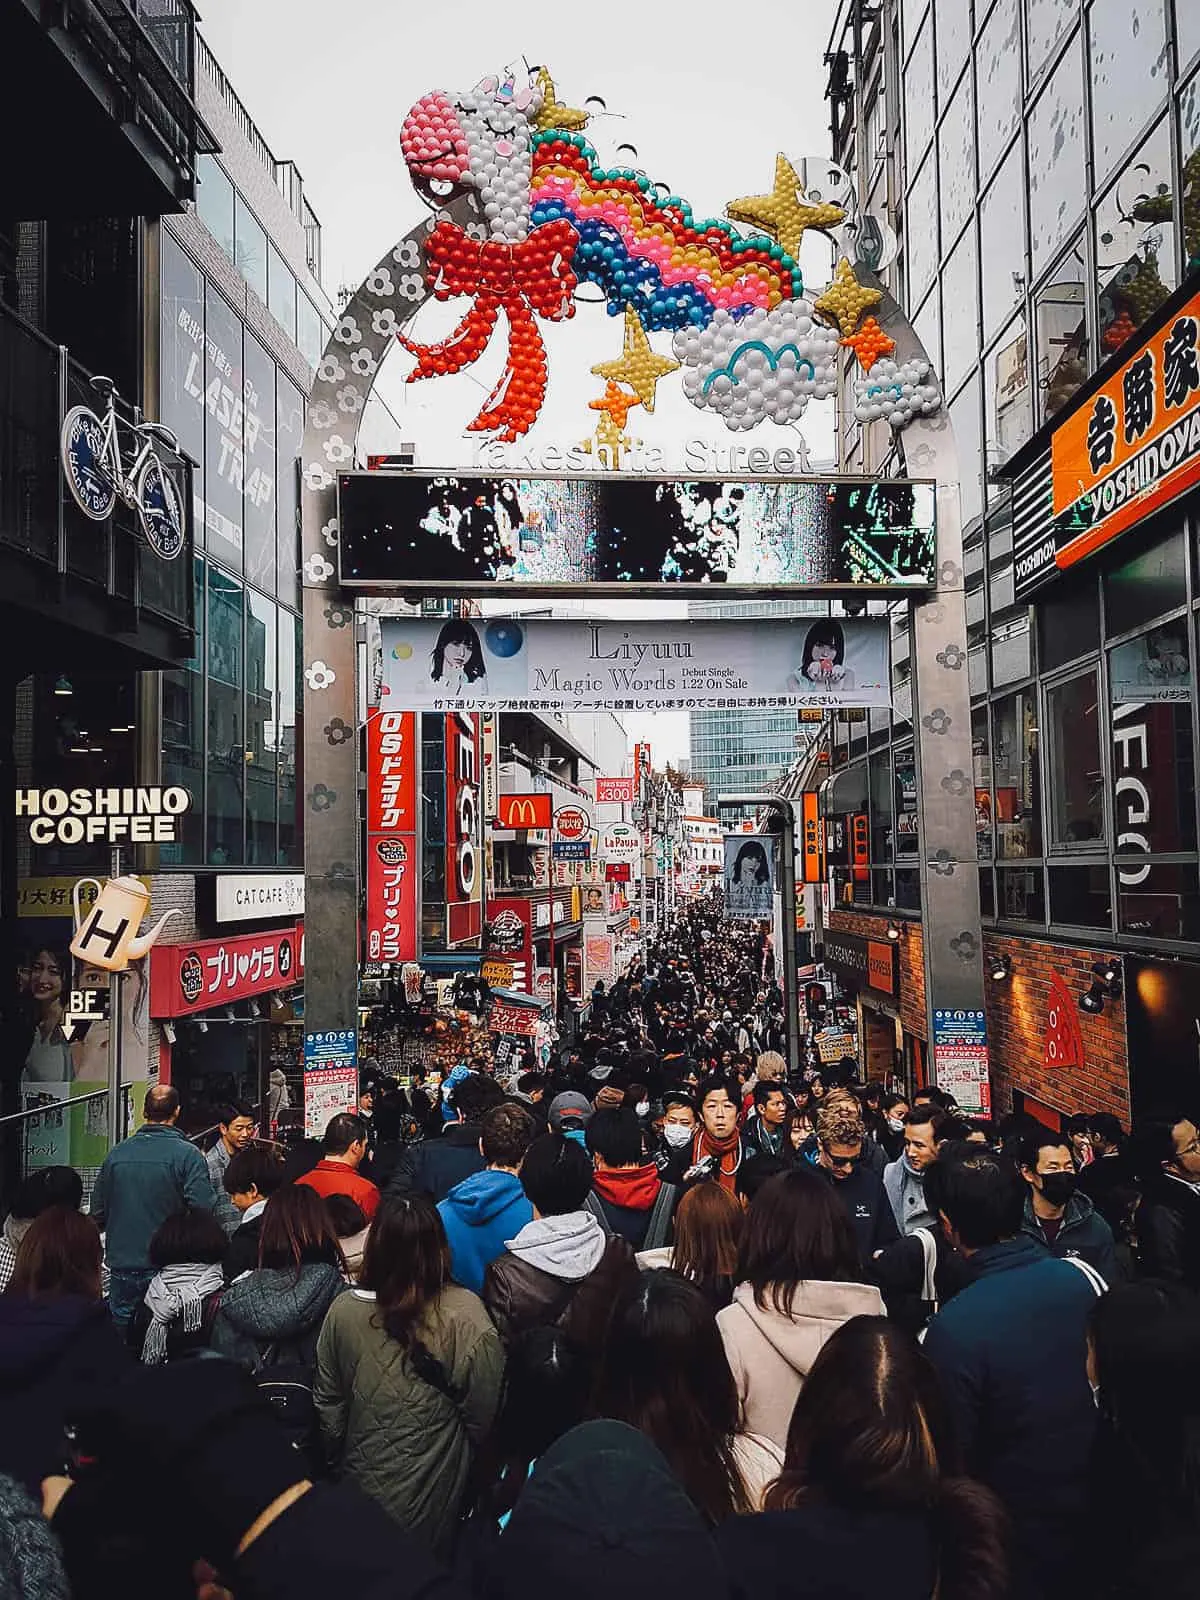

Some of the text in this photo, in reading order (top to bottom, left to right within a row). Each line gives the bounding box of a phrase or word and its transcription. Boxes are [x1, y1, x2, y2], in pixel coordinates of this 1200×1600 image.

[684, 439, 813, 472] Street
[1091, 411, 1200, 521] YOSHINOYA
[585, 623, 693, 667] Liyuu
[533, 667, 676, 696] Magic Words
[681, 668, 735, 678] Debut Single
[681, 678, 748, 690] 1.22 On Sale
[15, 786, 191, 816] HOSHINO
[29, 815, 175, 844] COFFEE
[80, 909, 130, 959] H
